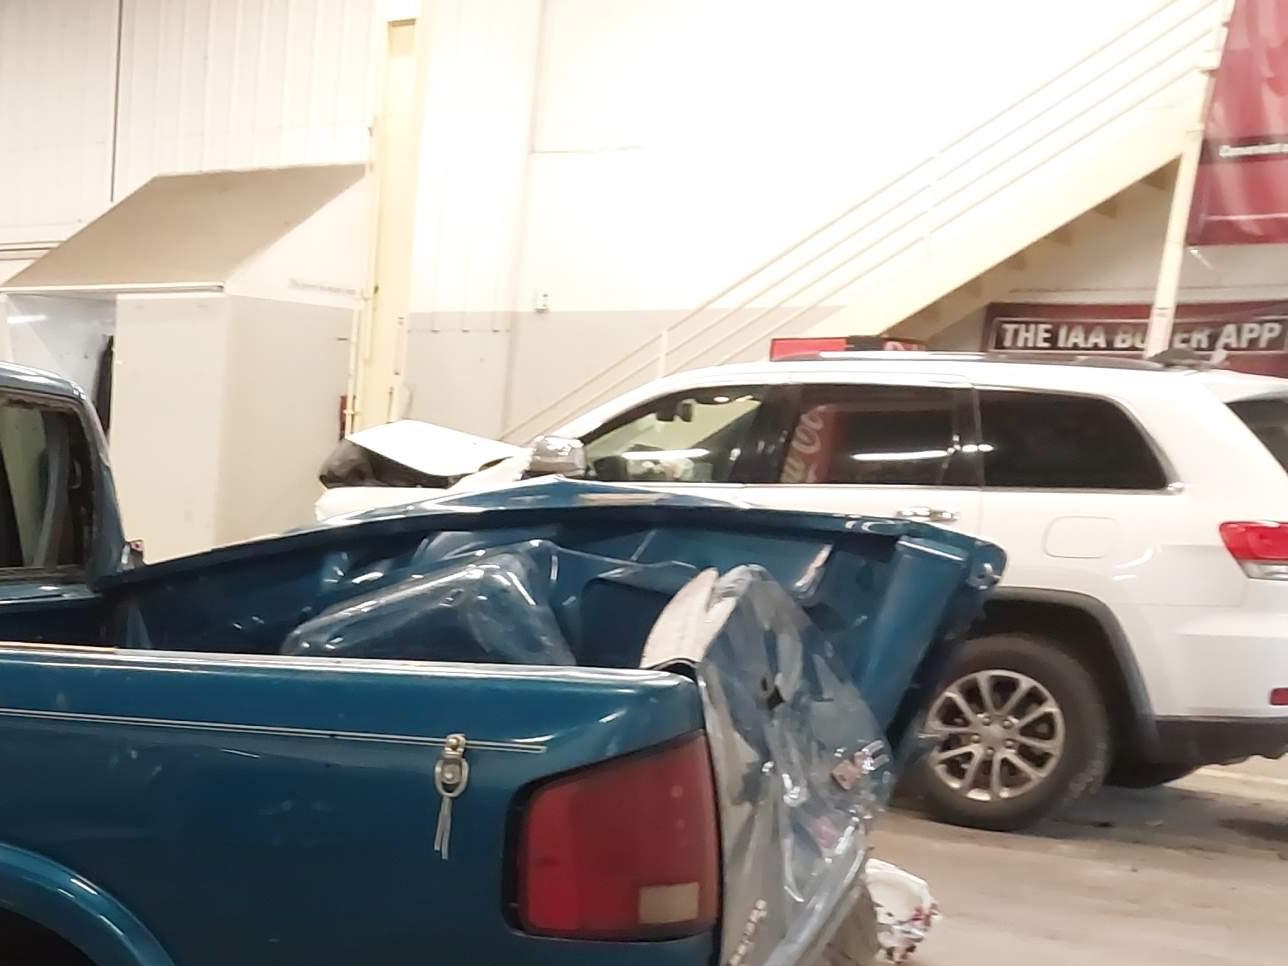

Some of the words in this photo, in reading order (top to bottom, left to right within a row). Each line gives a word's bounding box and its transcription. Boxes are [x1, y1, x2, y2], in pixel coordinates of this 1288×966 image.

[1001, 323, 1053, 349] THE
[1057, 324, 1108, 349] IAA
[1113, 325, 1210, 349] BUER
[1214, 322, 1283, 349] APP
